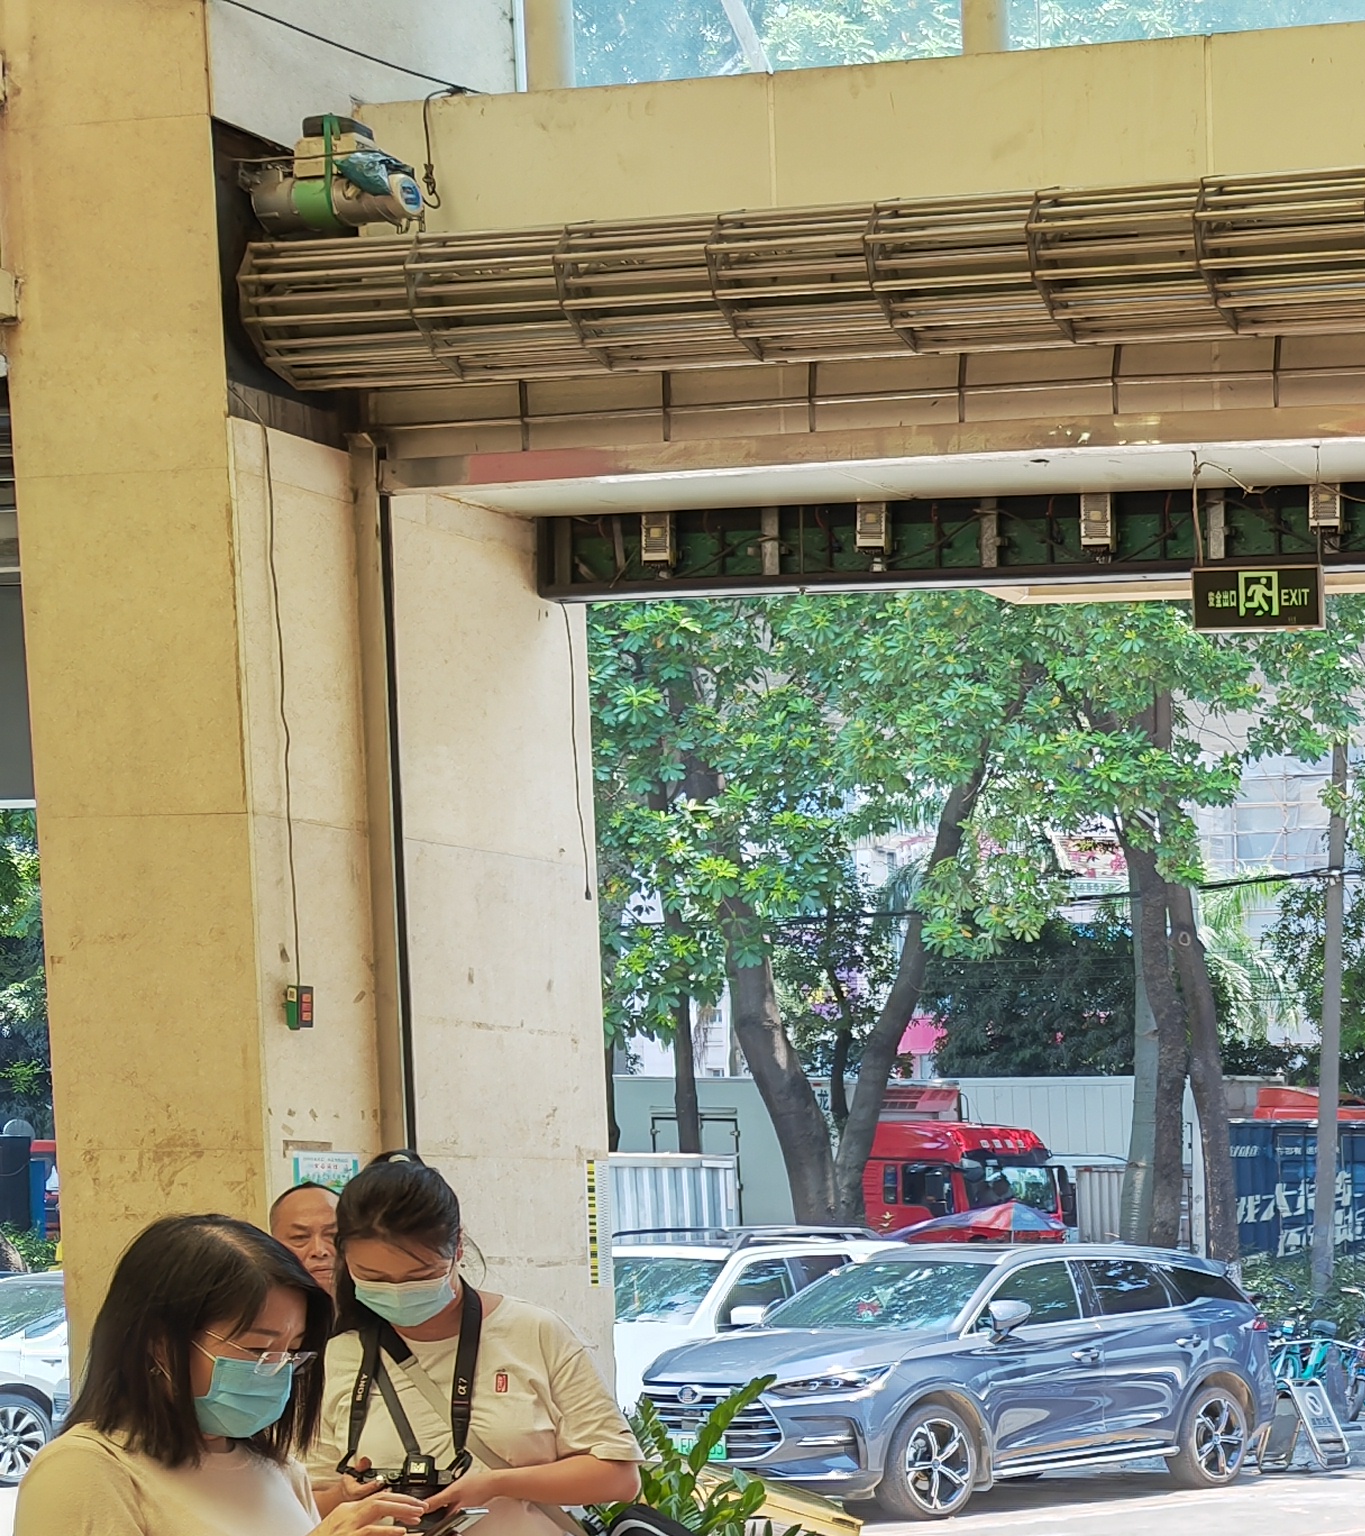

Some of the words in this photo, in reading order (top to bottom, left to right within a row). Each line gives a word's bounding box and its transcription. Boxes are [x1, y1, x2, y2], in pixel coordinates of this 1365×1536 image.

[1207, 590, 1237, 607] 安全出口
[1281, 588, 1310, 606] EXIT
[355, 1373, 368, 1402] SONY
